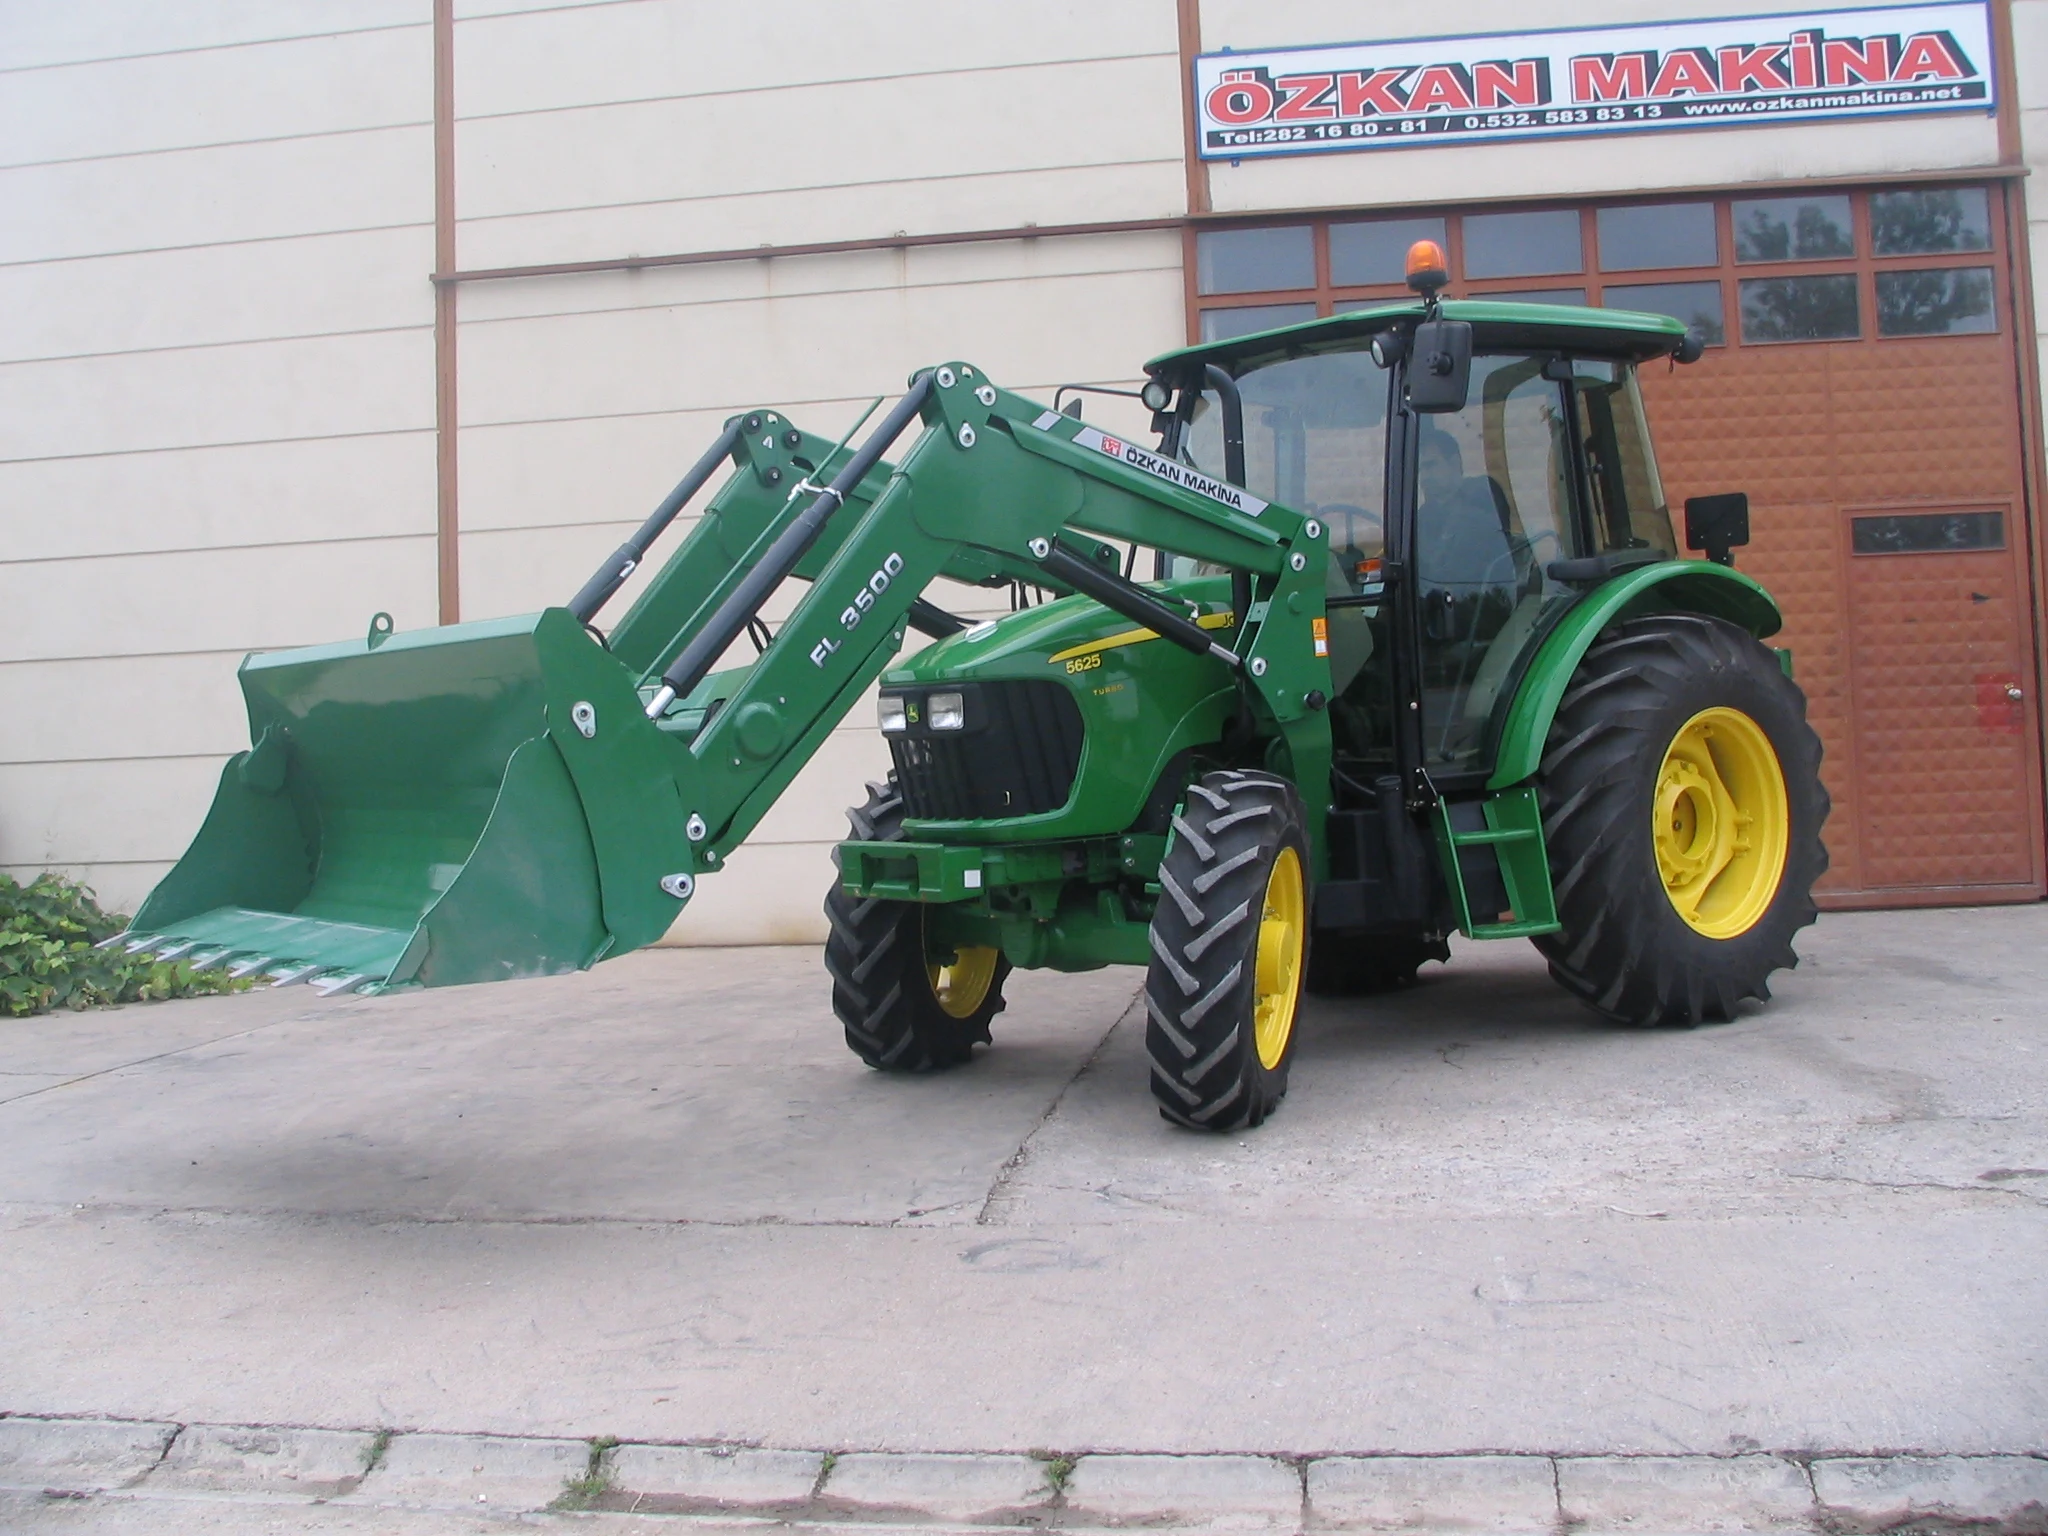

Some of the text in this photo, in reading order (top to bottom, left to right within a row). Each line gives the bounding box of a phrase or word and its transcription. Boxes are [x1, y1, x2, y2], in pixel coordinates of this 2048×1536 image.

[1205, 59, 1548, 126] ÖZKAN
[1314, 125, 1342, 139] 16
[1350, 122, 1379, 136] 80
[1400, 119, 1427, 133] 81
[1545, 109, 1588, 124] 583
[1596, 106, 1625, 121] 83
[1633, 105, 1662, 118] 13
[1683, 86, 1962, 116] www.ozkanmakina.net
[1126, 446, 1181, 482] ÖZKAN
[809, 551, 905, 669] FL 3500
[1065, 654, 1102, 675] 5625
[1093, 683, 1125, 696] TURBO
